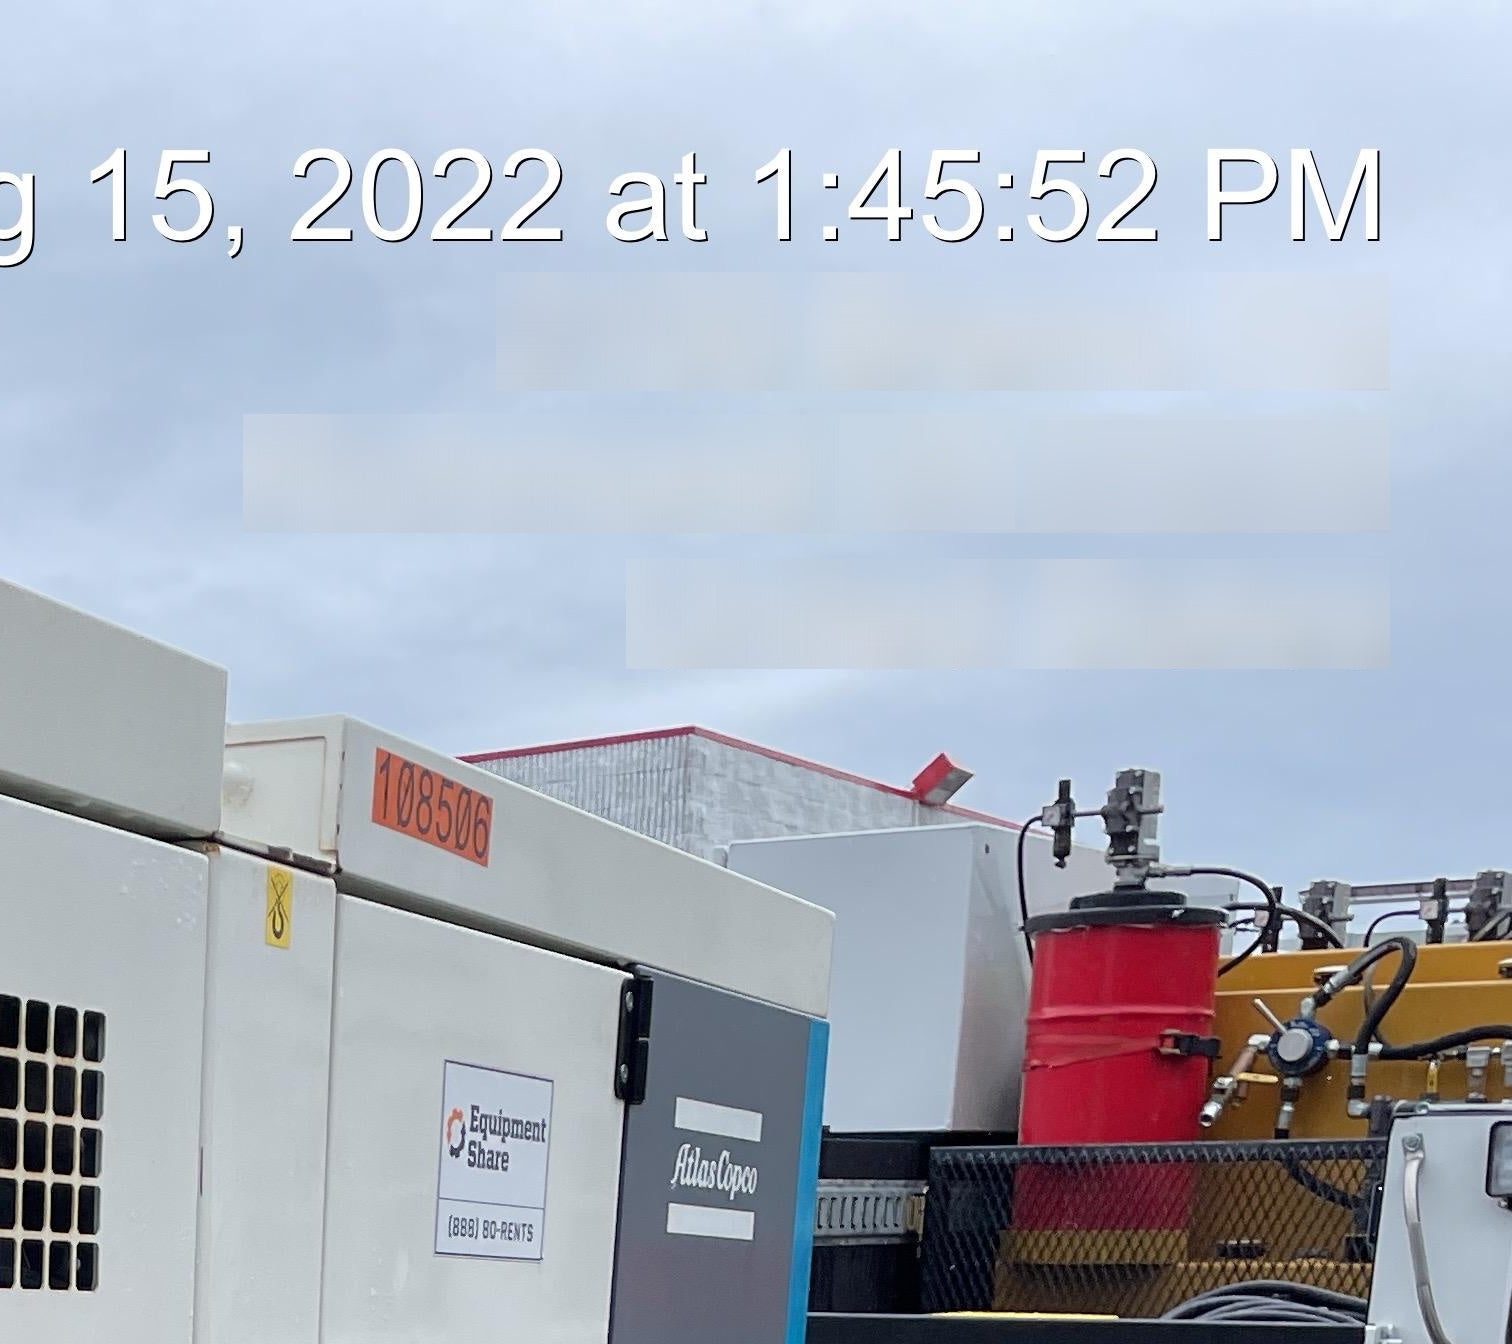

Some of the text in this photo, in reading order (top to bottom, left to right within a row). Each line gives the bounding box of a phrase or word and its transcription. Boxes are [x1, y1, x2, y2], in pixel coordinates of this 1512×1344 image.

[377, 752, 490, 858] 108506
[469, 1104, 546, 1145] Equipment
[467, 1139, 510, 1172] Share
[447, 1213, 534, 1243] (888) 80-RENTS
